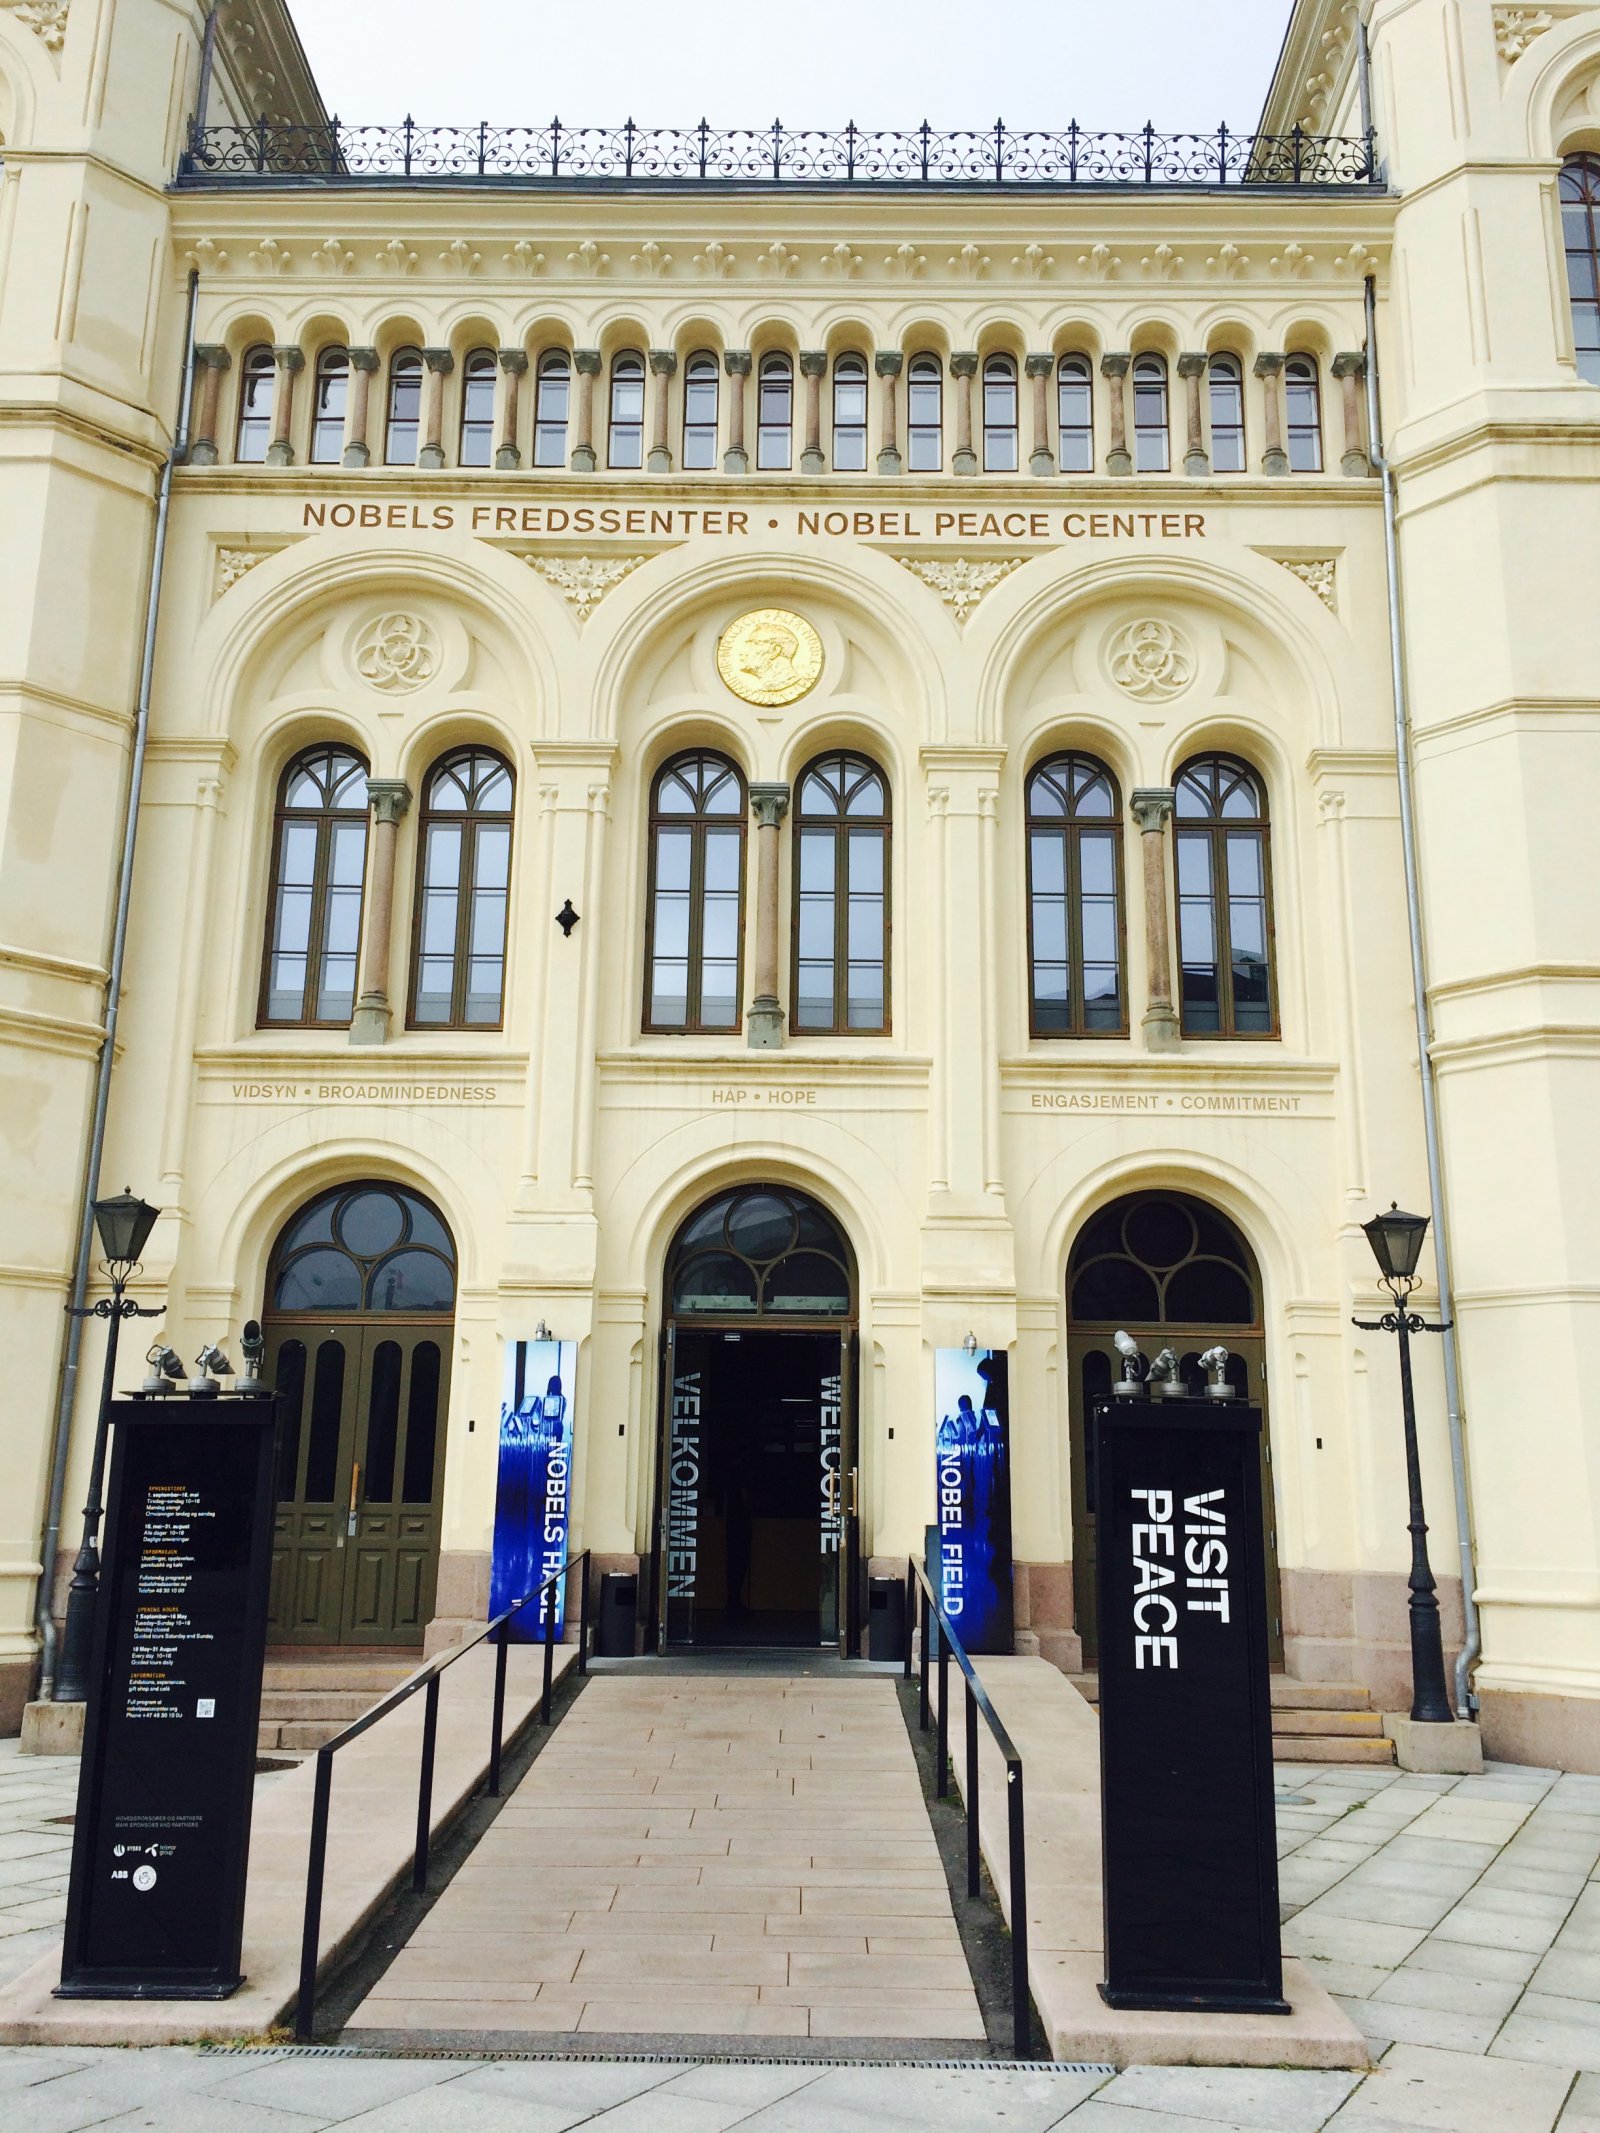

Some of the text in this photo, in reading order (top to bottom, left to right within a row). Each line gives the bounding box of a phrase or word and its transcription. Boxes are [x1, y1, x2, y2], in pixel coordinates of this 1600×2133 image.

[303, 504, 1206, 538] NOBELS FREDSSENTER NOBEL PEACE CENTER
[232, 1084, 497, 1100] VIDSYN BROADMINDEDNESS
[712, 1087, 816, 1104] HÅP HOPE
[1031, 1094, 1300, 1111] ENGASJEMENT COMMITMENT
[543, 1440, 568, 1543] NOBELS
[667, 1372, 701, 1598] VELKOMMEN
[820, 1375, 841, 1554] WELCOME
[940, 1444, 964, 1616] NOBEL FIELD
[1131, 1489, 1178, 1670] PEACE
[1184, 1489, 1230, 1623] VISIT
[111, 1870, 128, 1879] ABB
